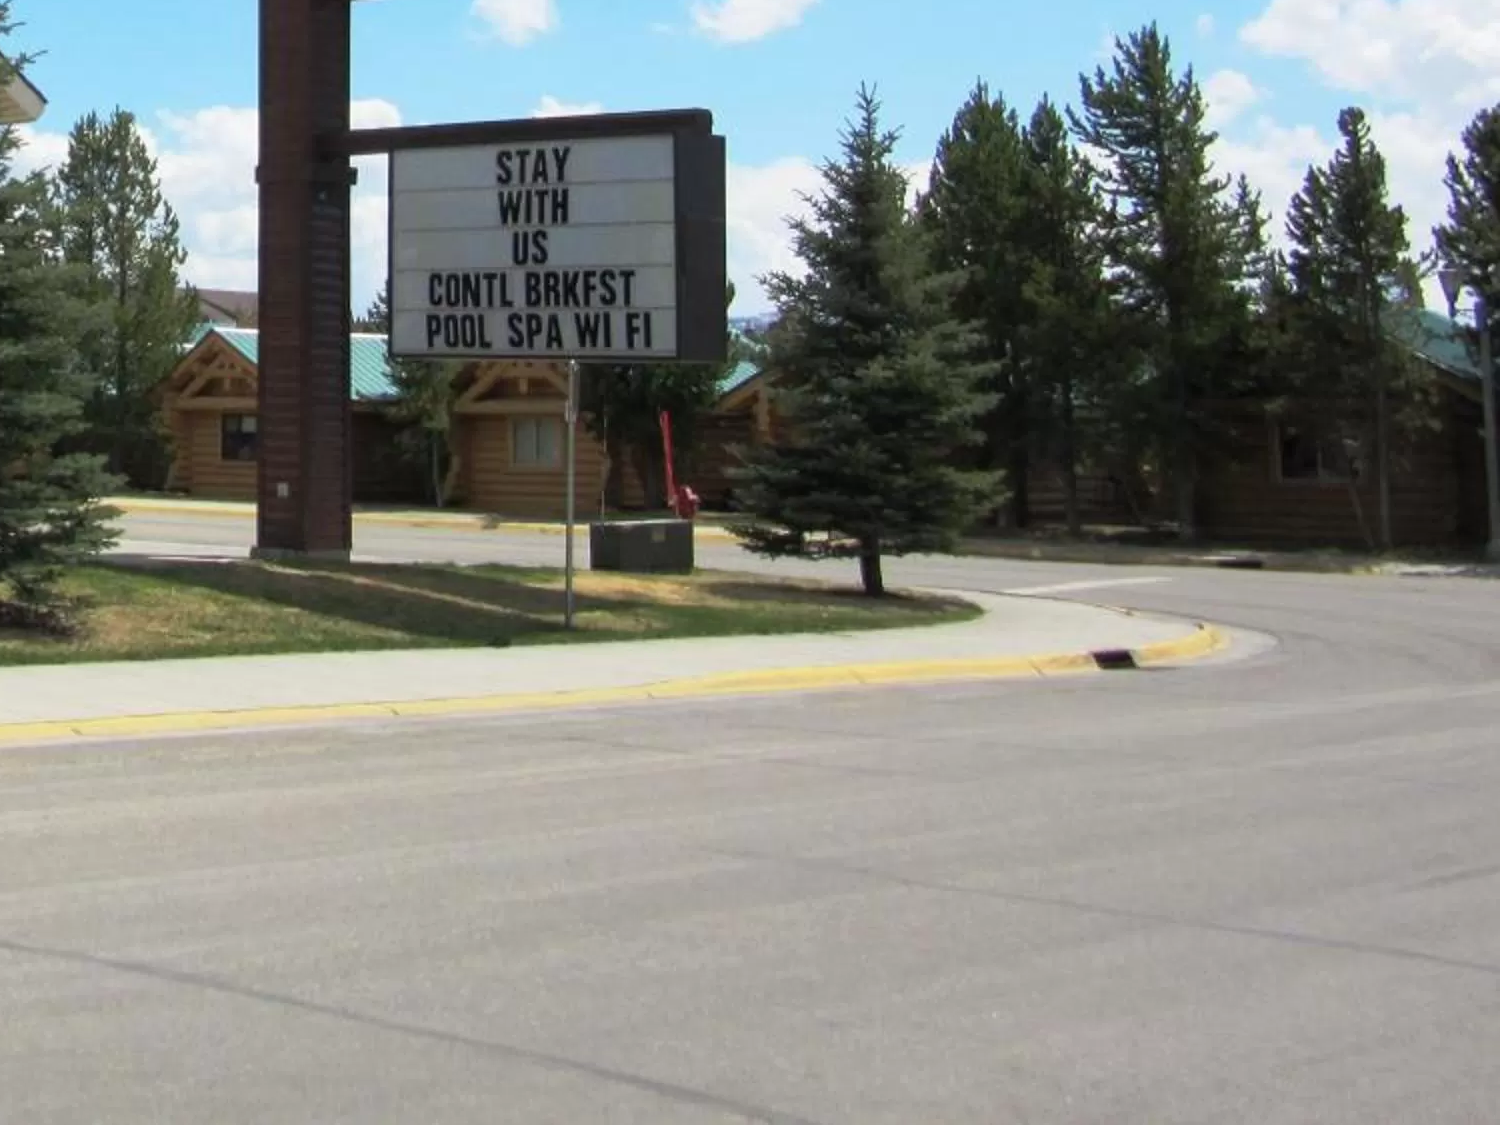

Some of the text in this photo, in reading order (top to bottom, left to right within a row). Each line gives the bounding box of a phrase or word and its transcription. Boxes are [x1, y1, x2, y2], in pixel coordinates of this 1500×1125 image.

[496, 146, 571, 185] STAY
[497, 188, 569, 225] WITH
[513, 229, 548, 266] US
[428, 270, 636, 307] CONTL BRKFST
[426, 311, 651, 349] POOL SPA WI FI
